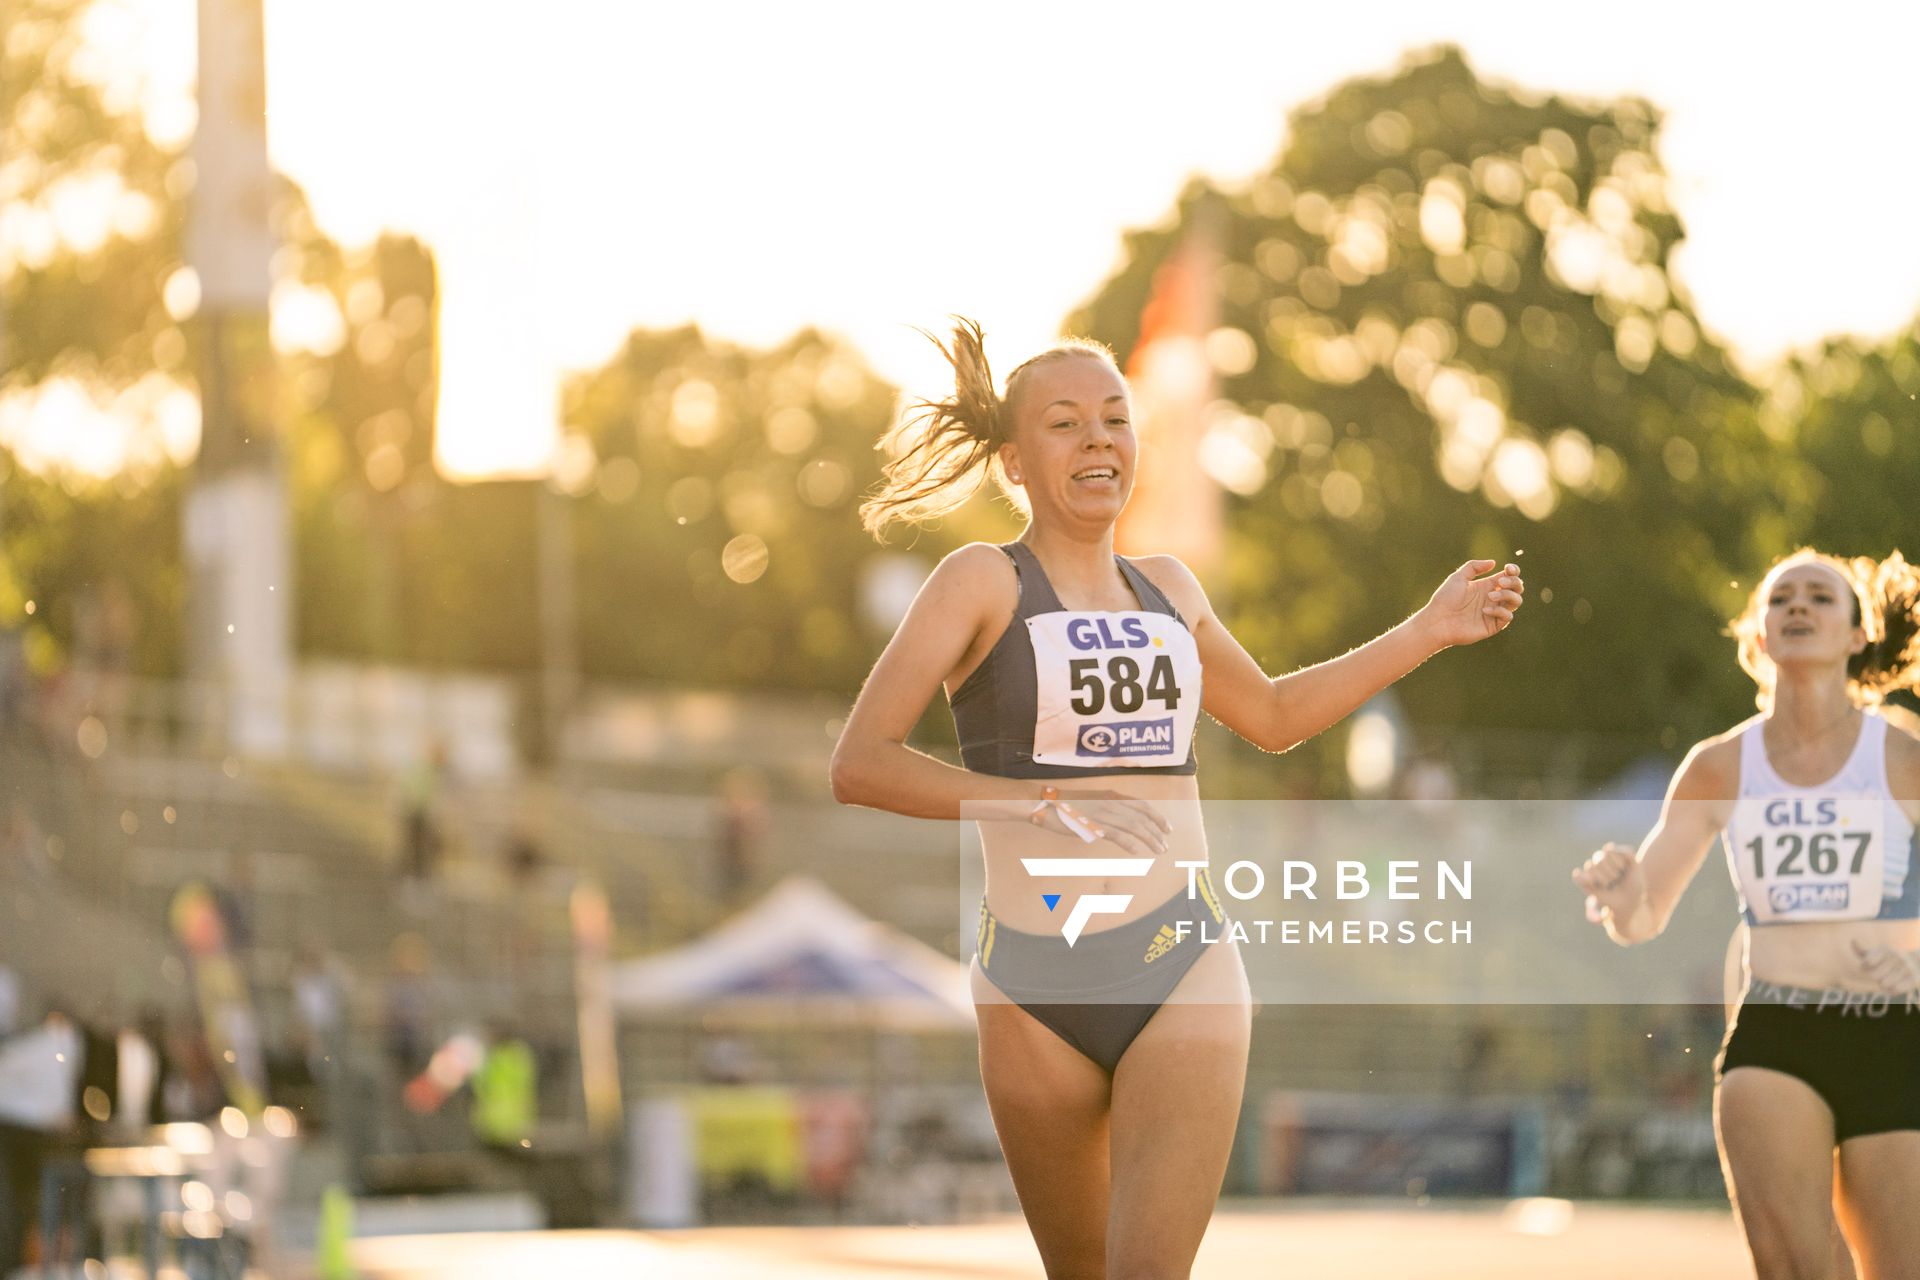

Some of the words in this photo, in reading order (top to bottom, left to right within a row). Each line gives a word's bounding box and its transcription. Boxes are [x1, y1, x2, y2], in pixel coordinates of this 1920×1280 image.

[1069, 655, 1181, 716] 584
[1119, 725, 1171, 745] PLAN
[1119, 744, 1170, 753] INTERNATIONAL
[1746, 831, 1872, 879] 1267
[1816, 986, 1891, 1018] PRO
